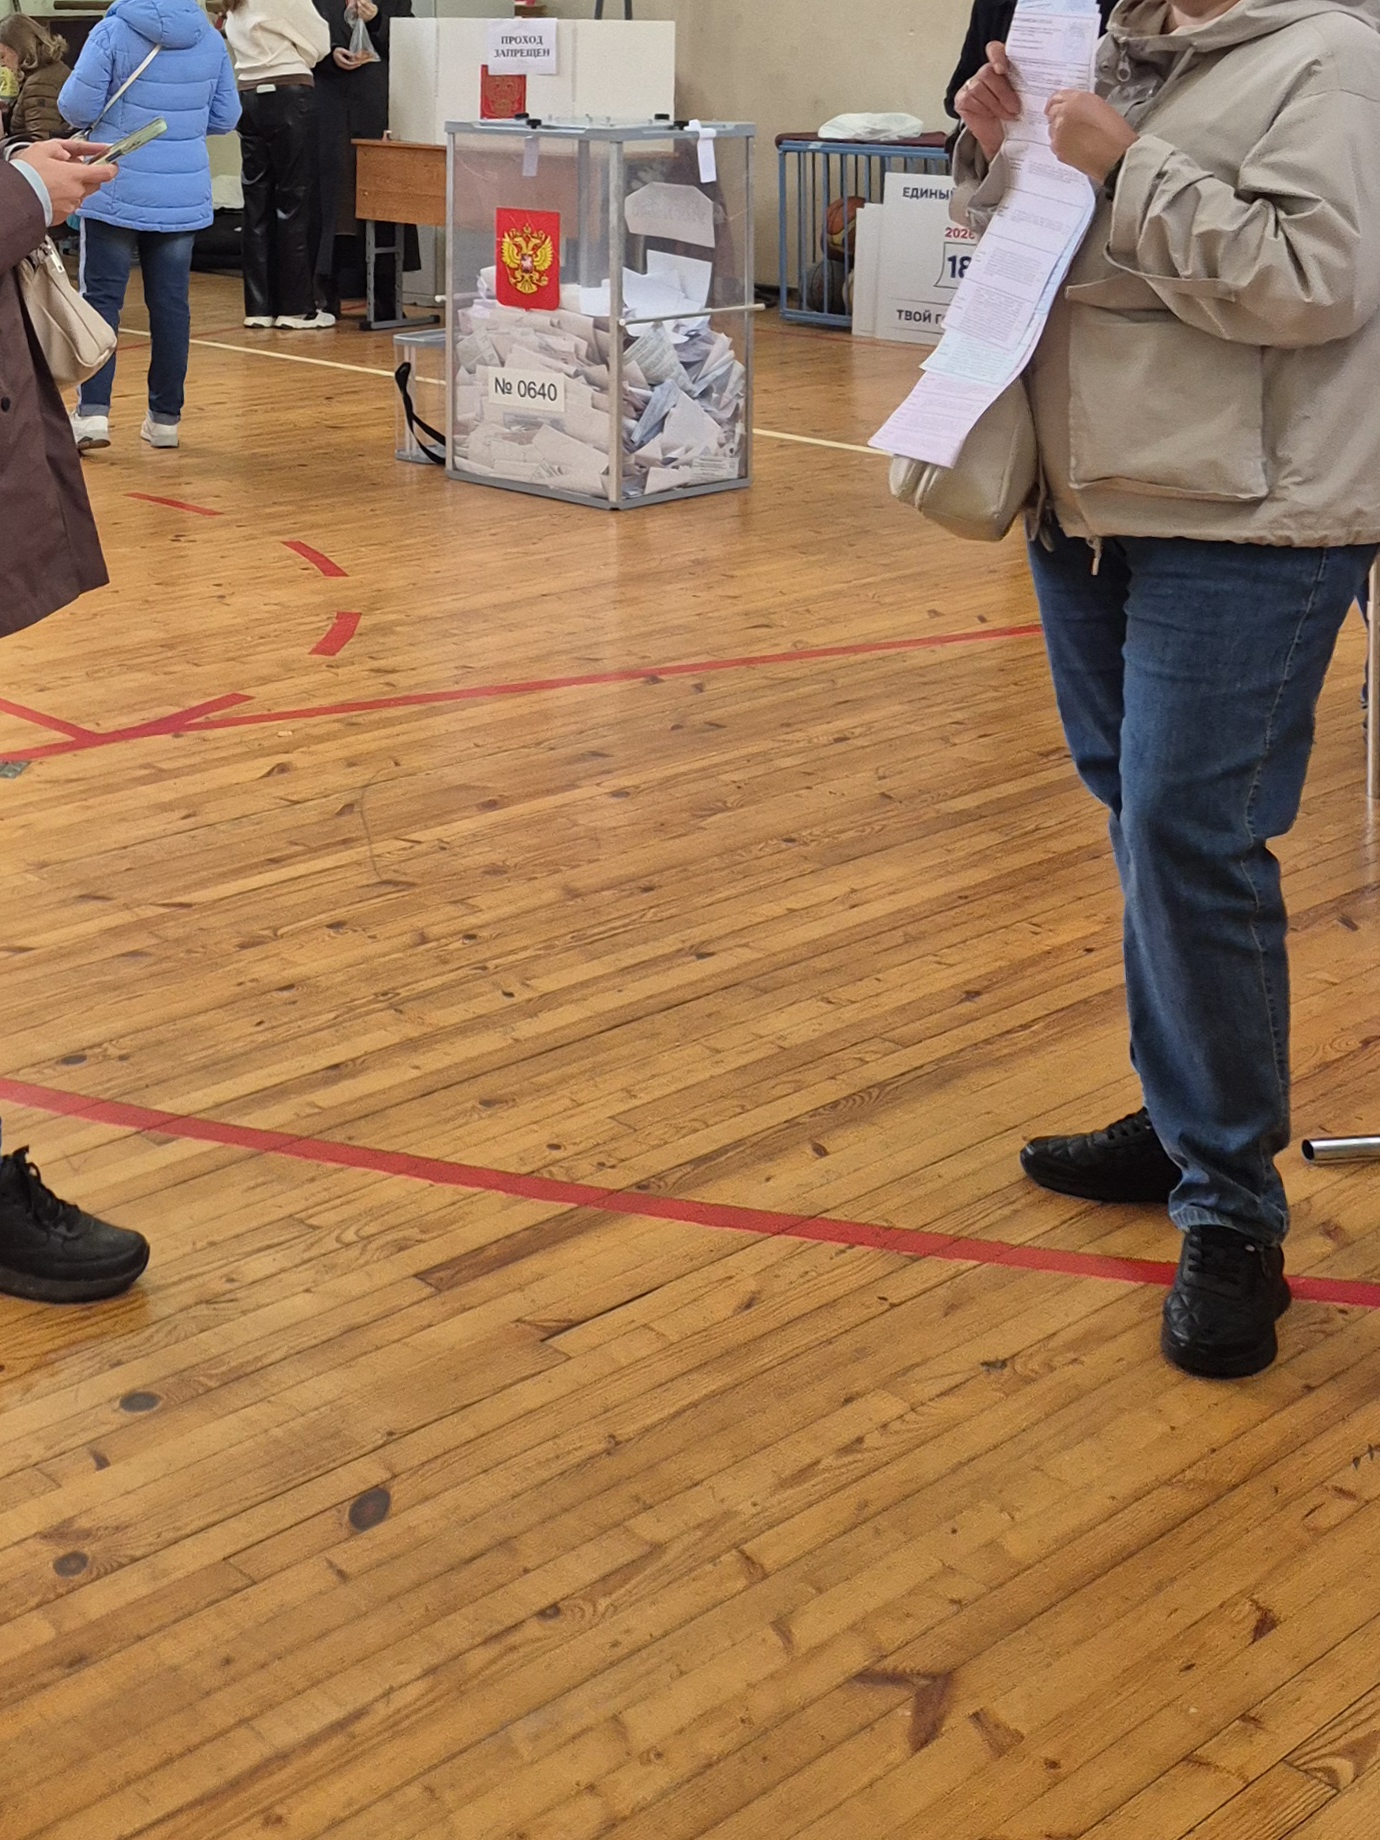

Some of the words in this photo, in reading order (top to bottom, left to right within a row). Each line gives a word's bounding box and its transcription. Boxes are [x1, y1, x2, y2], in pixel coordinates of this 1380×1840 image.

[501, 36, 543, 45] ПРОХОД
[494, 49, 550, 58] ЗАПРЕЩЕН
[896, 309, 931, 323] ТВОЙ
[495, 377, 513, 395] №
[517, 380, 557, 401] 0640
